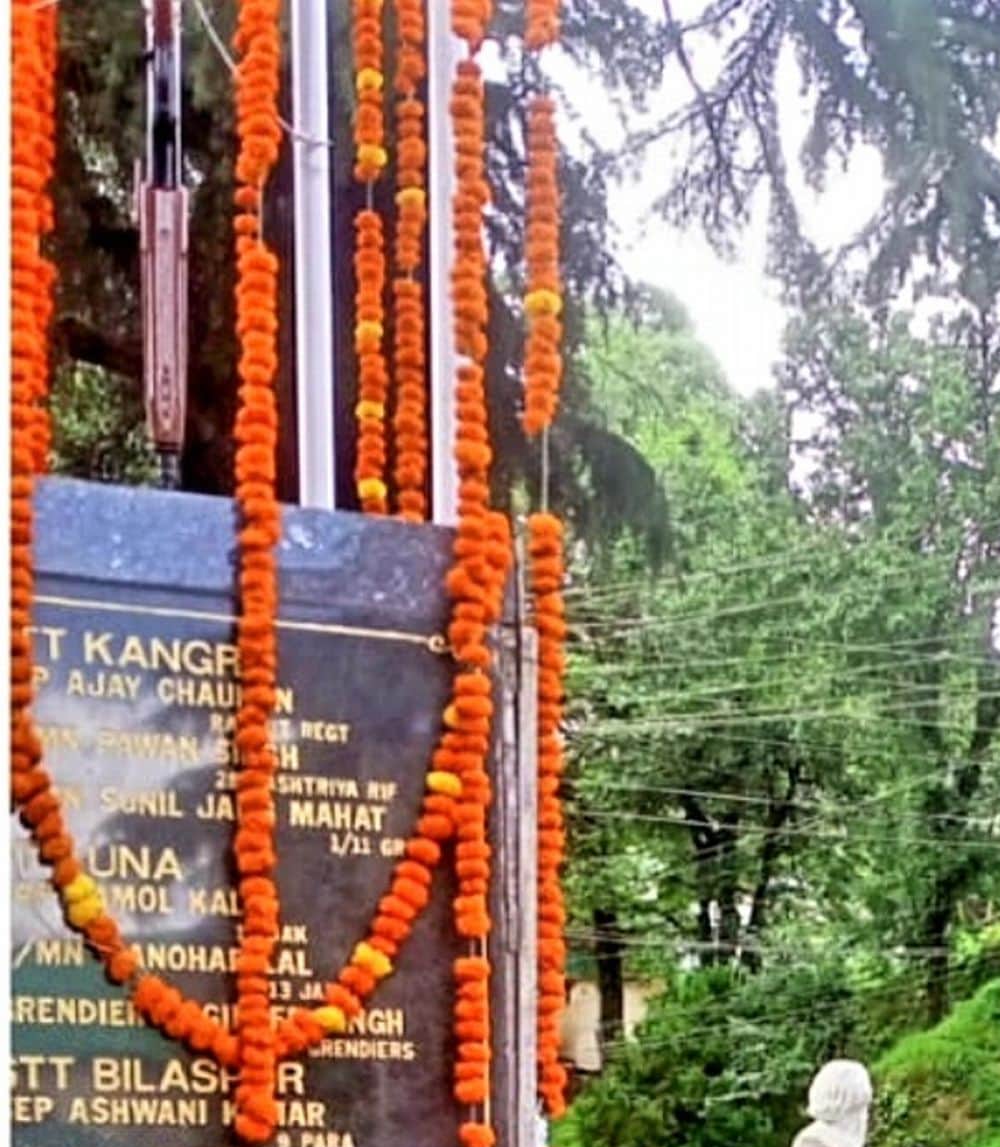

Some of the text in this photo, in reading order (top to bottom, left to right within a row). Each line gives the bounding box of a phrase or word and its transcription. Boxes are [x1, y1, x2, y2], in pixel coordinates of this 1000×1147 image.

[84, 631, 241, 676] KANGR
[67, 668, 141, 700] AJAY
[158, 680, 293, 714] CHAUN
[277, 774, 358, 798] SHTRIYA
[101, 786, 183, 818] SUNIL
[289, 800, 387, 832] MAHAT
[330, 831, 371, 856] 1/11
[88, 844, 183, 880] UNA
[98, 884, 173, 914] MOL
[308, 1039, 416, 1061] RENDIERS
[12, 1095, 54, 1123] EP
[69, 1097, 207, 1126] ASHWANI
